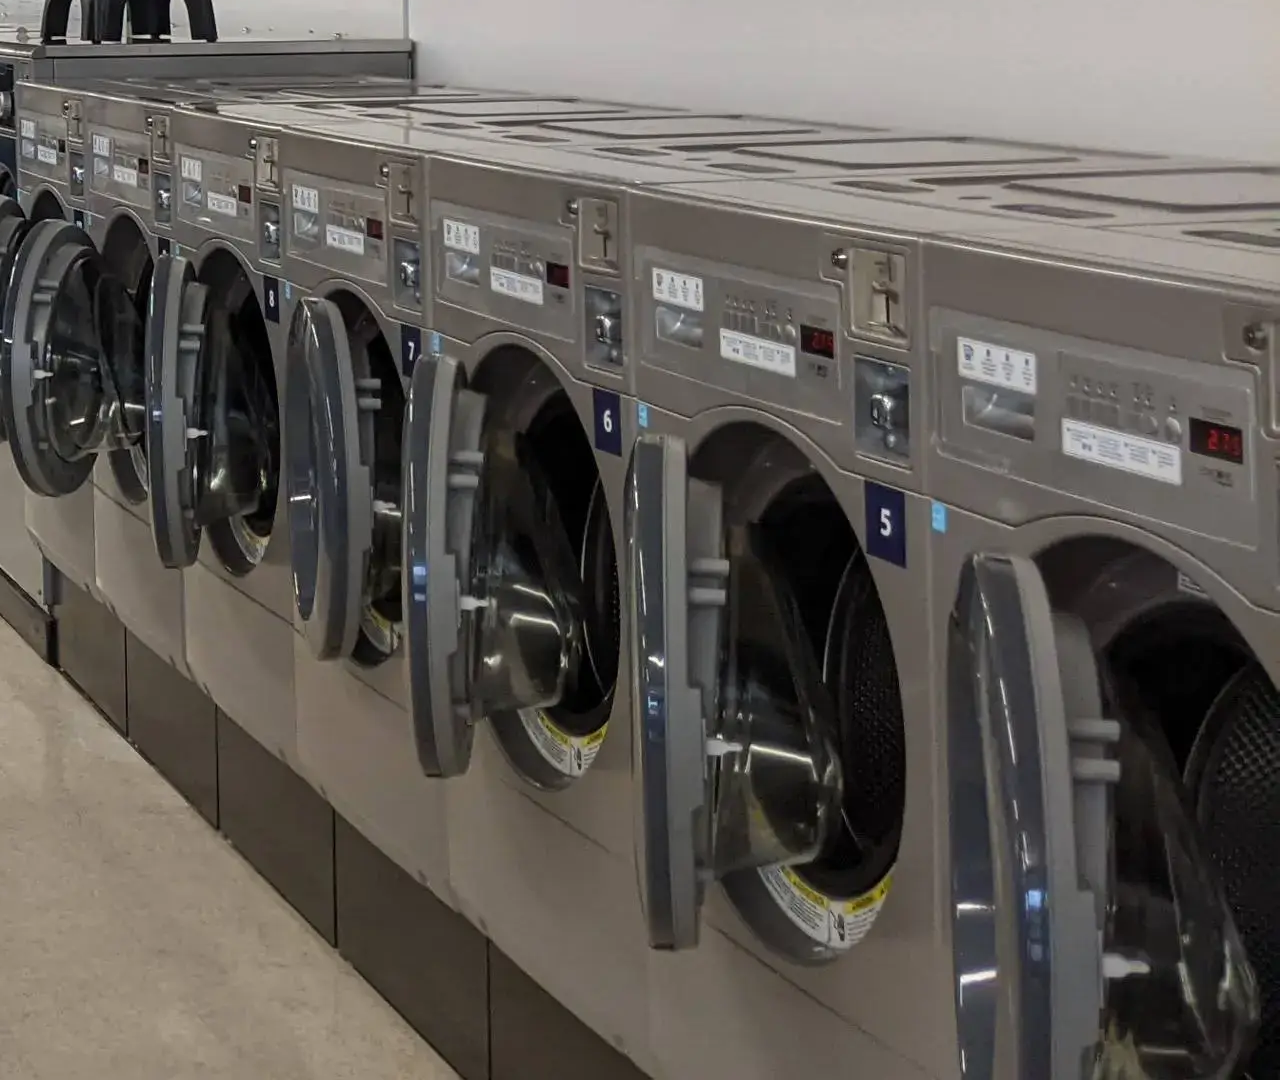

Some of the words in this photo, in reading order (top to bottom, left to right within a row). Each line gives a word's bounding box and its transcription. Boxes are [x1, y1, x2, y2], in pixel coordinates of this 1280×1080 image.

[268, 289, 275, 308] 8
[407, 341, 415, 361] 7
[603, 409, 612, 433] 6
[880, 507, 892, 537] 5
